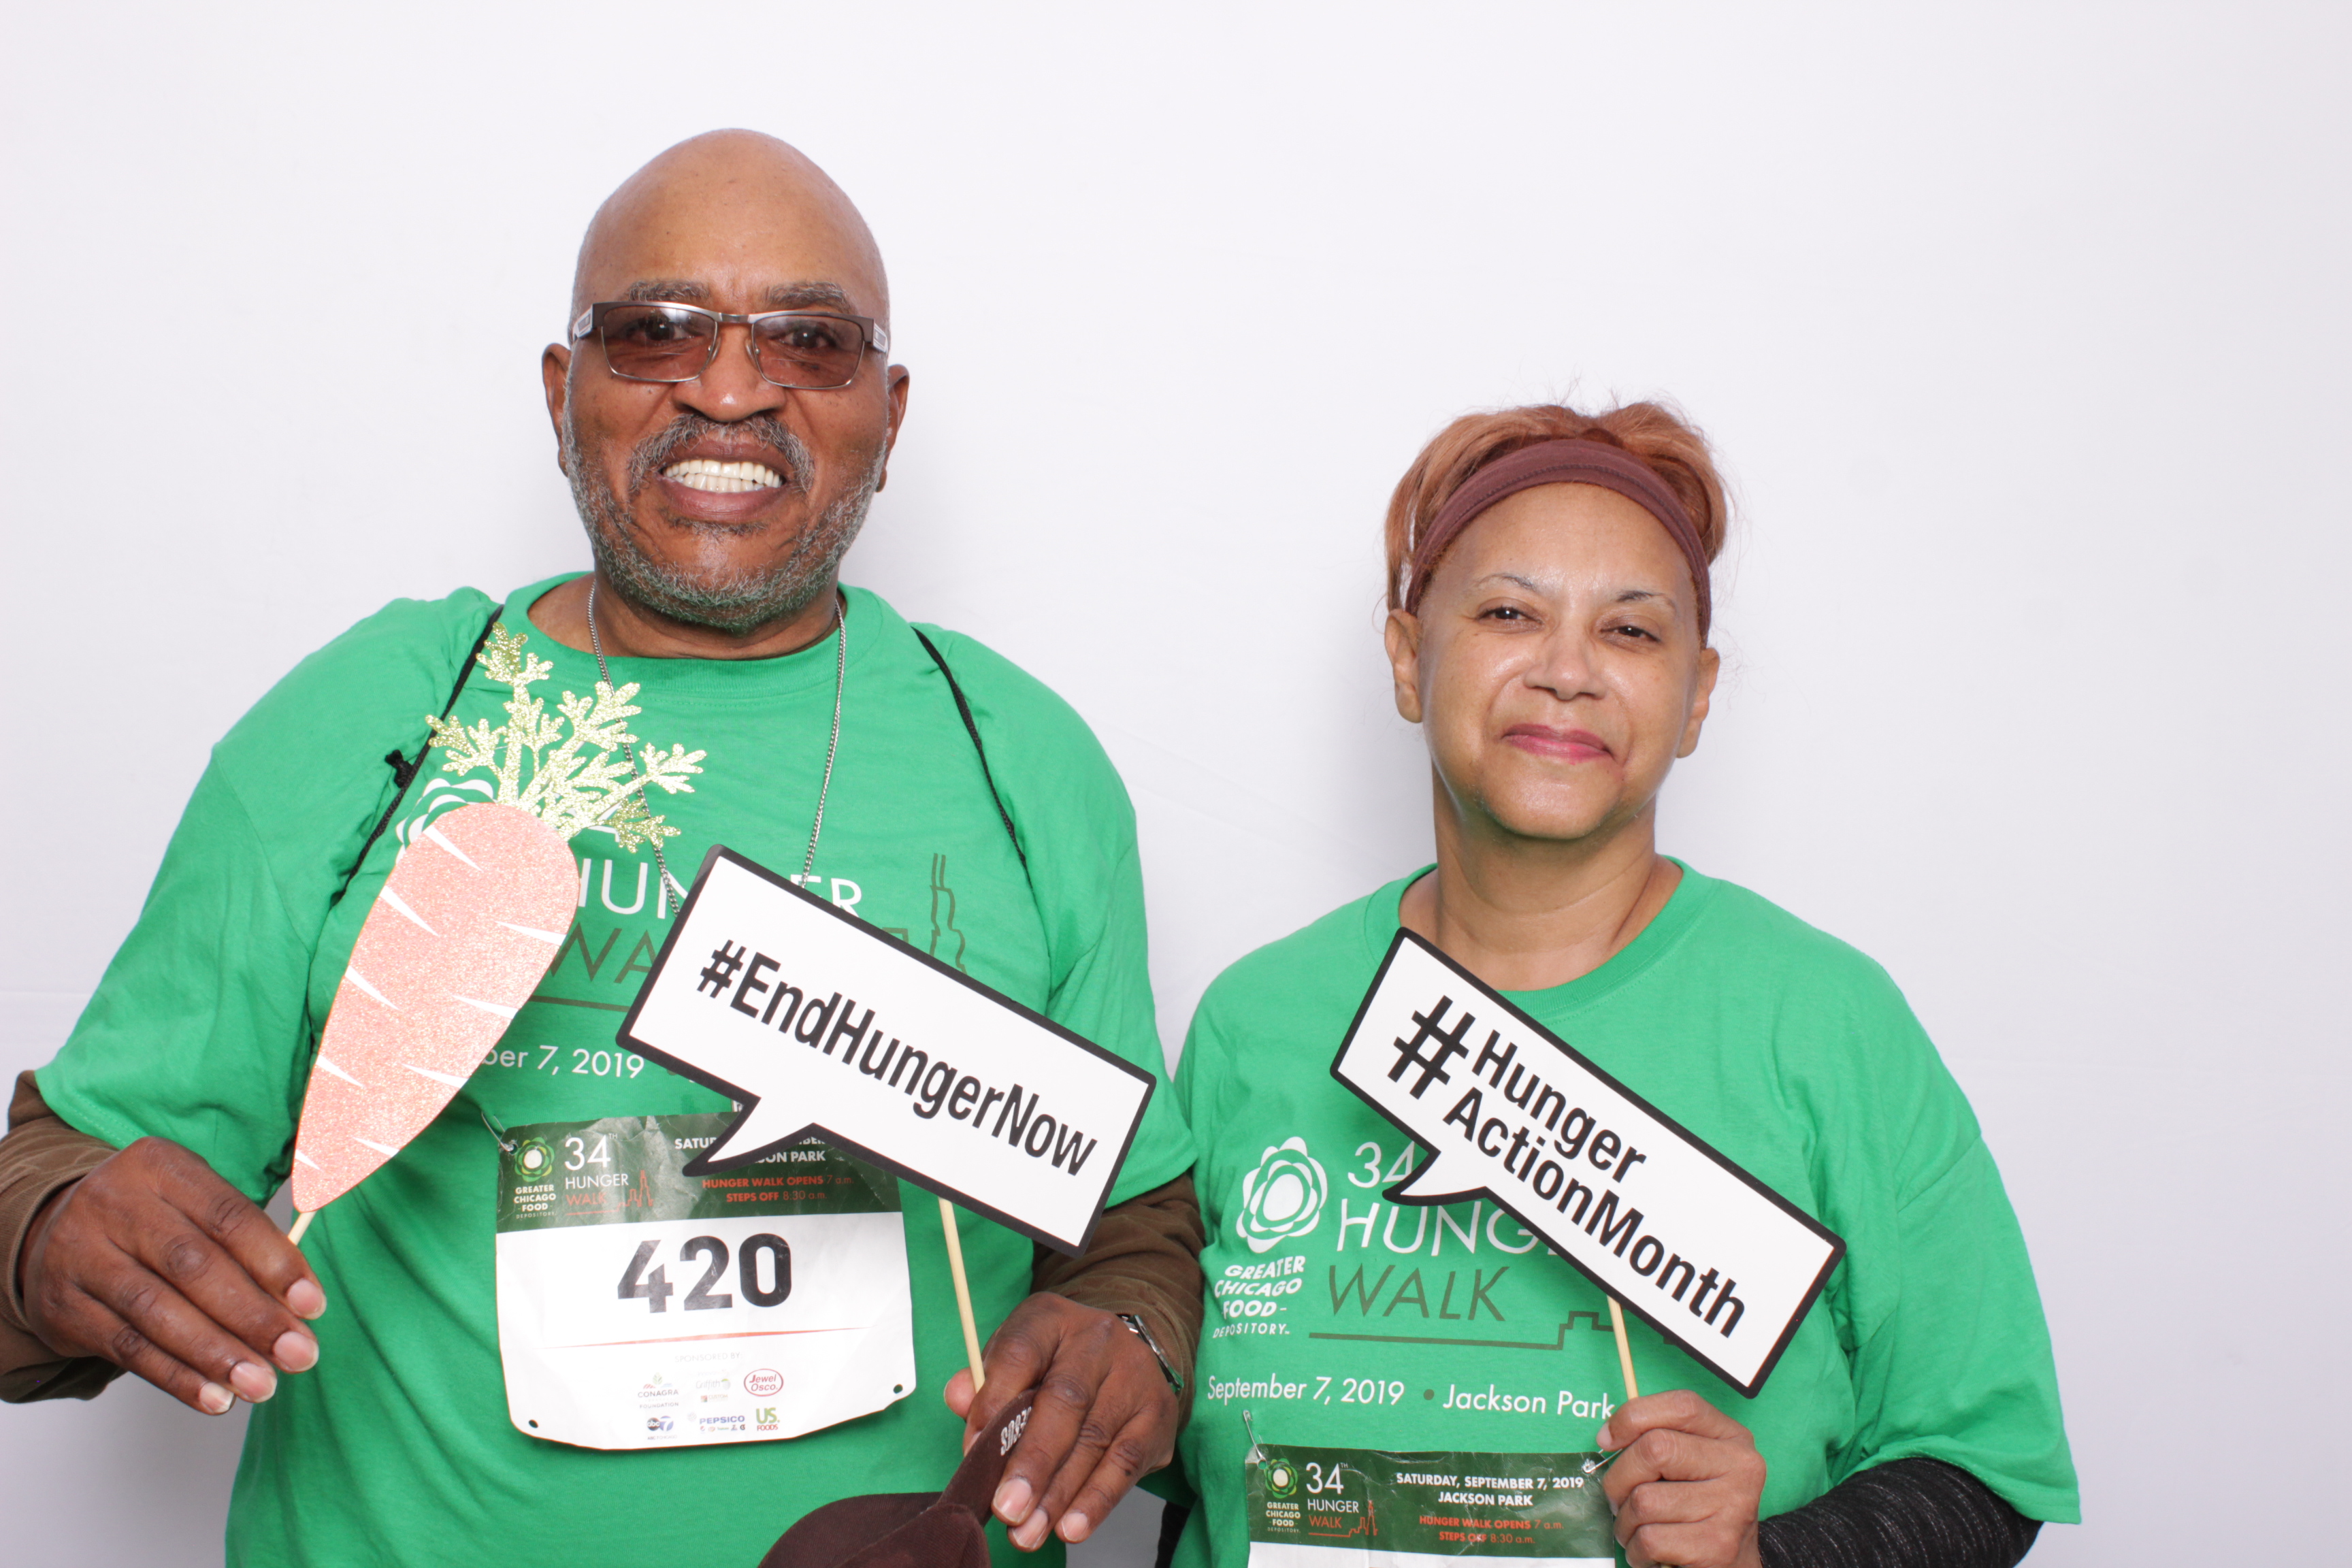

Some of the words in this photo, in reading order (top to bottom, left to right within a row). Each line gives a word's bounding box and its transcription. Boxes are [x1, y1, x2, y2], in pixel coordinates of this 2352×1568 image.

[537, 1045, 560, 1075] 7,
[572, 1048, 644, 1079] 2019
[696, 939, 1098, 1177] #EndHungerNow
[791, 1150, 826, 1162] PARK
[565, 1173, 629, 1190] HUNGER
[702, 1178, 749, 1188] HUNGER
[751, 1177, 784, 1187] WALK
[787, 1175, 823, 1186] OPENS
[826, 1175, 833, 1184] 7
[835, 1175, 854, 1184] a.m.
[515, 1184, 555, 1194] GREATER
[514, 1193, 556, 1204] CHICAGO
[566, 1192, 608, 1207] WALK
[726, 1192, 756, 1203] STEPS
[759, 1192, 779, 1201] OFF
[783, 1191, 806, 1200] 8:30
[808, 1191, 828, 1199] a.m.
[521, 1203, 549, 1212] FOOD
[1442, 1086, 1746, 1339] ActionMonth
[1337, 1198, 1558, 1256] HUNG
[617, 1233, 791, 1313] 420
[1224, 1256, 1306, 1279] GREATER
[1214, 1277, 1303, 1298] CHICAGO
[1329, 1263, 1509, 1322] WALK
[675, 1352, 728, 1362] SPONSORED
[749, 1373, 777, 1383] Jewel
[638, 1389, 679, 1398] CONAGRA
[1207, 1372, 1307, 1406] September
[1312, 1376, 1333, 1405] 7,
[1341, 1377, 1405, 1405] 2019
[1443, 1384, 1546, 1414] Jackson
[1557, 1390, 1615, 1420] Park
[700, 1416, 745, 1424] PEPSICO
[1396, 1473, 1460, 1488] SATURDAY,
[1465, 1475, 1534, 1490] SEPTEMBER
[1537, 1477, 1548, 1490] 7,
[1552, 1476, 1584, 1488] 2019
[1267, 1501, 1299, 1510] GREATER
[1438, 1492, 1494, 1505] JACKSON
[1498, 1494, 1533, 1506] PARK
[1307, 1499, 1359, 1514] HUNGER
[1266, 1509, 1301, 1518] CHICAGO
[1272, 1518, 1294, 1526] FOOD
[1309, 1515, 1342, 1529] WALK
[1419, 1516, 1460, 1527] HUNGER
[1462, 1518, 1492, 1529] WALK
[1494, 1519, 1531, 1529] OPENS
[1534, 1520, 1541, 1529] 7
[1544, 1521, 1565, 1529] a.m.
[1439, 1531, 1467, 1541] STEPS
[1467, 1533, 1487, 1543] OFF
[1490, 1533, 1514, 1543] 8:30
[1516, 1535, 1535, 1544] a.m.
